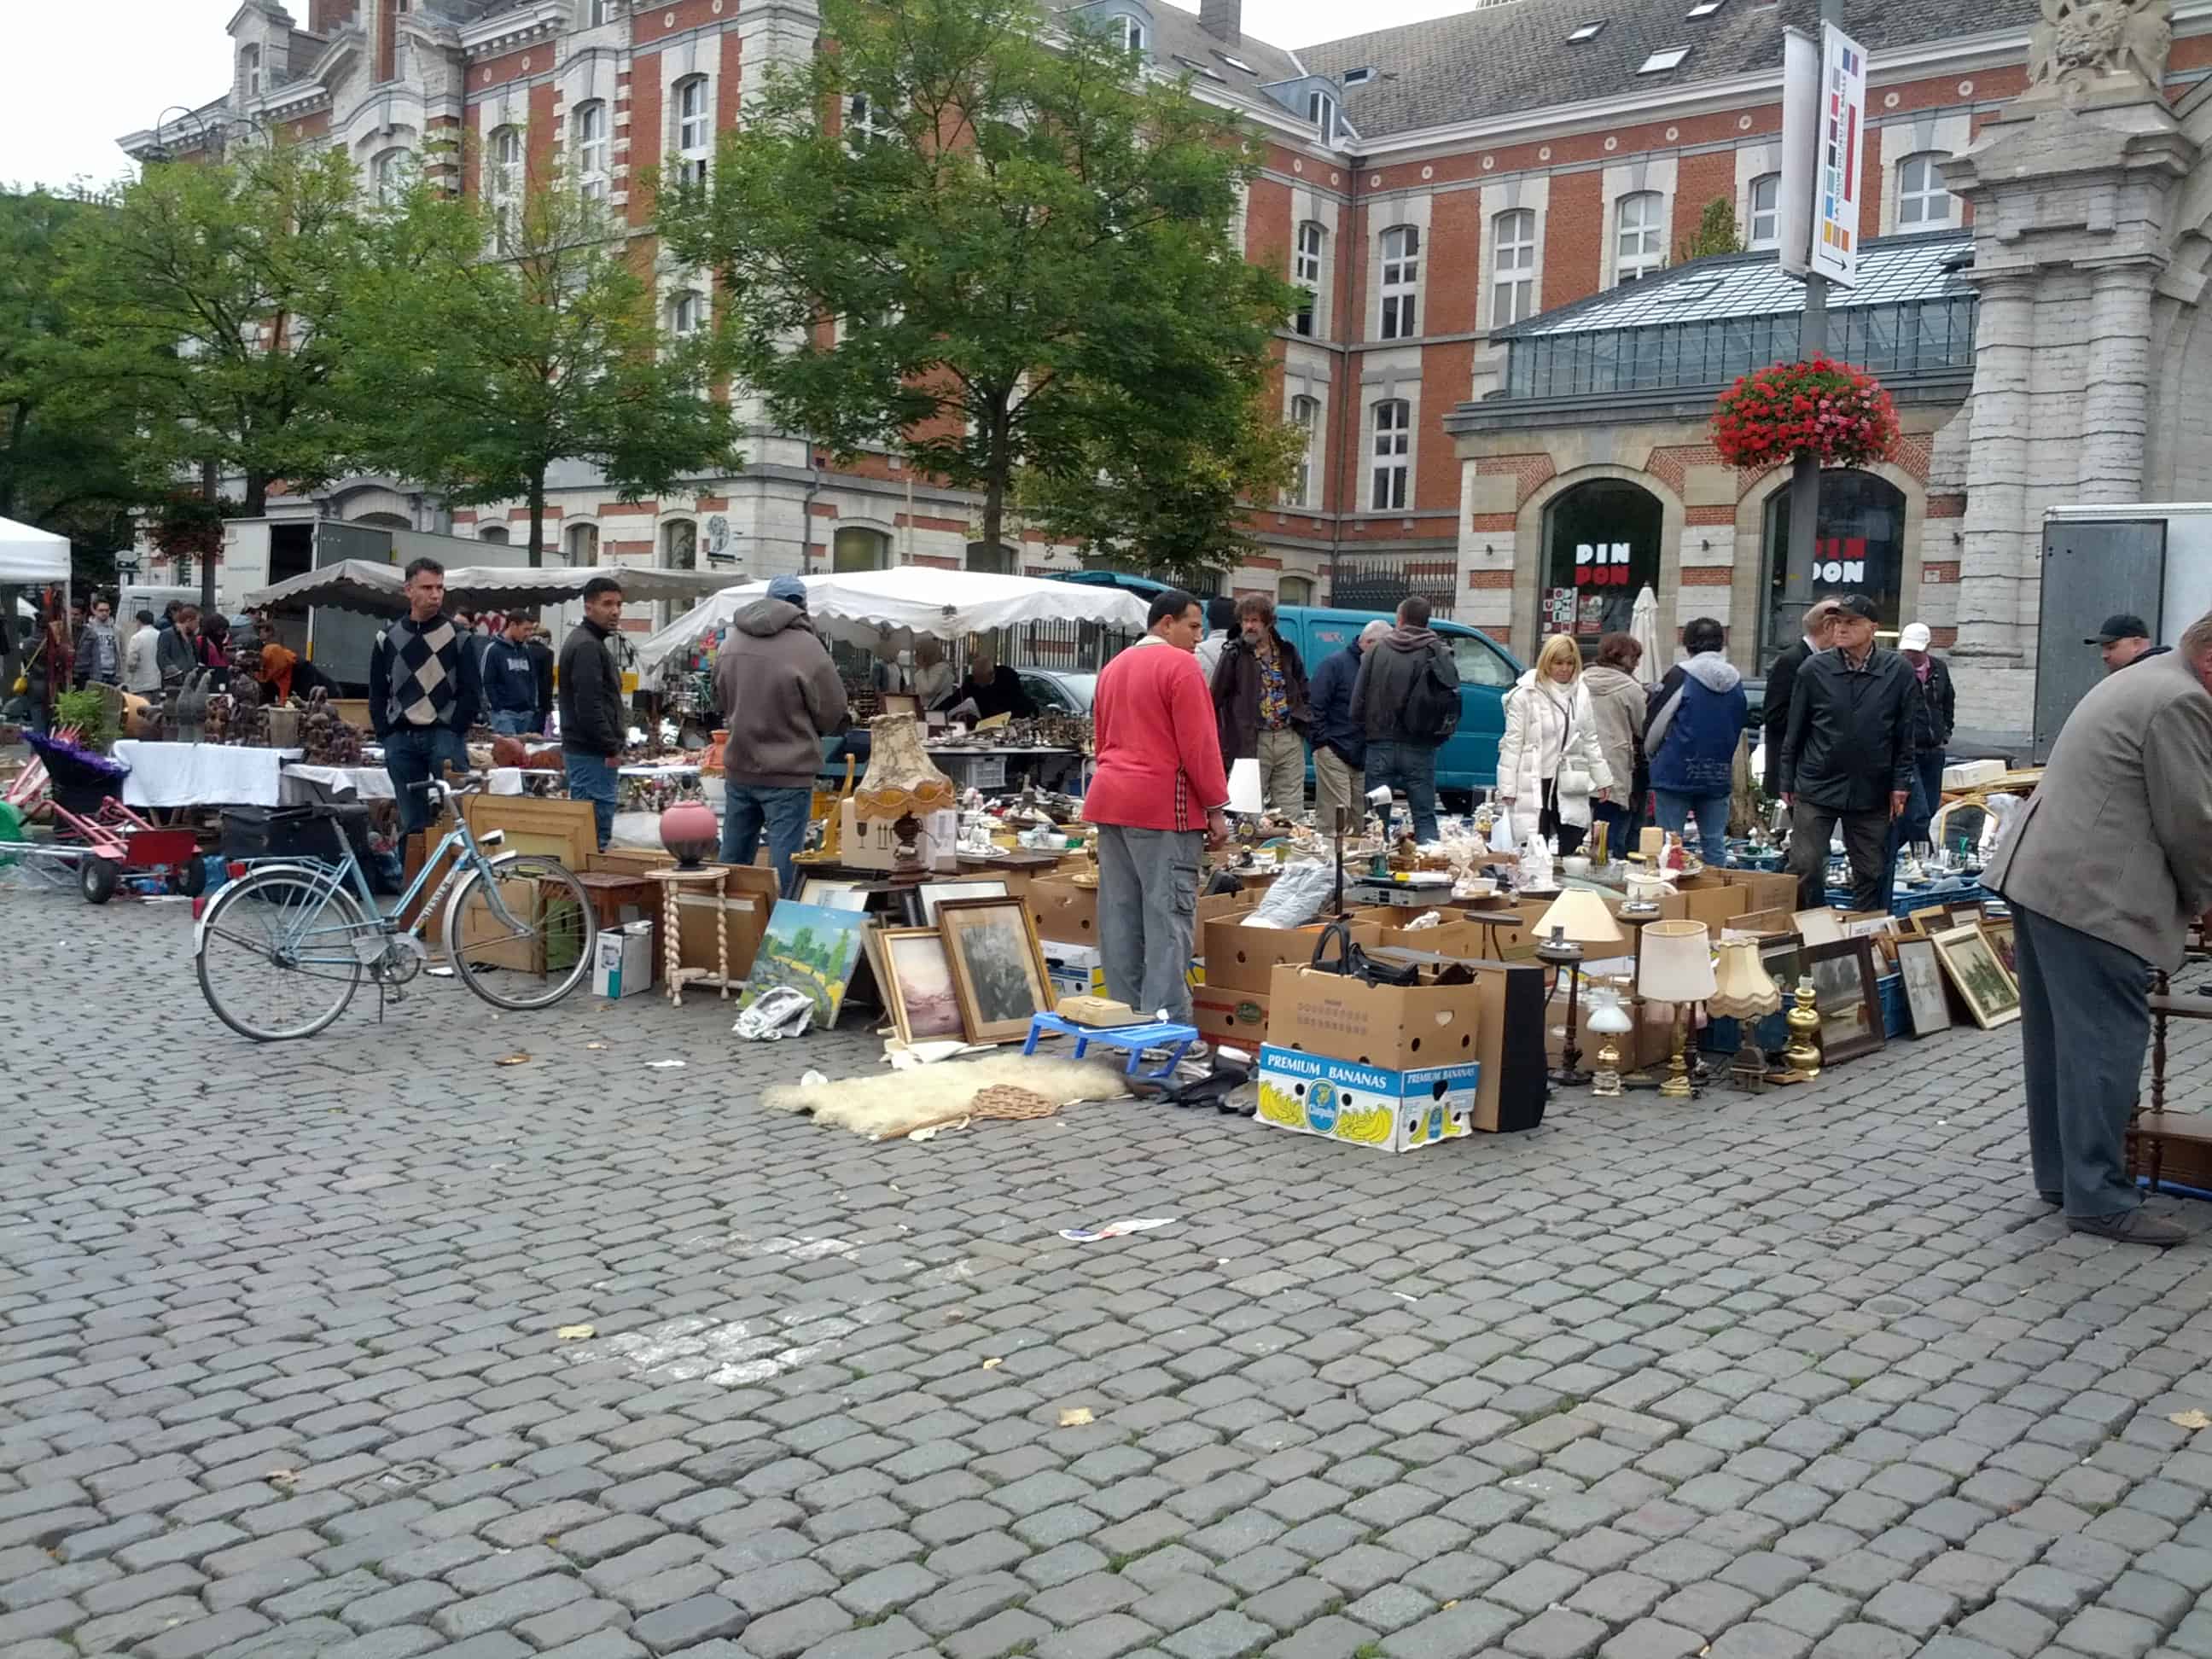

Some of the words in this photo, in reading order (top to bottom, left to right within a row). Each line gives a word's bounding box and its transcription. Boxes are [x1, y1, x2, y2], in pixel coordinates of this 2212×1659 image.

[1575, 543, 1631, 564] PIN
[1267, 1054, 1321, 1075] PREMIUM
[1328, 1065, 1387, 1089] BANANAS
